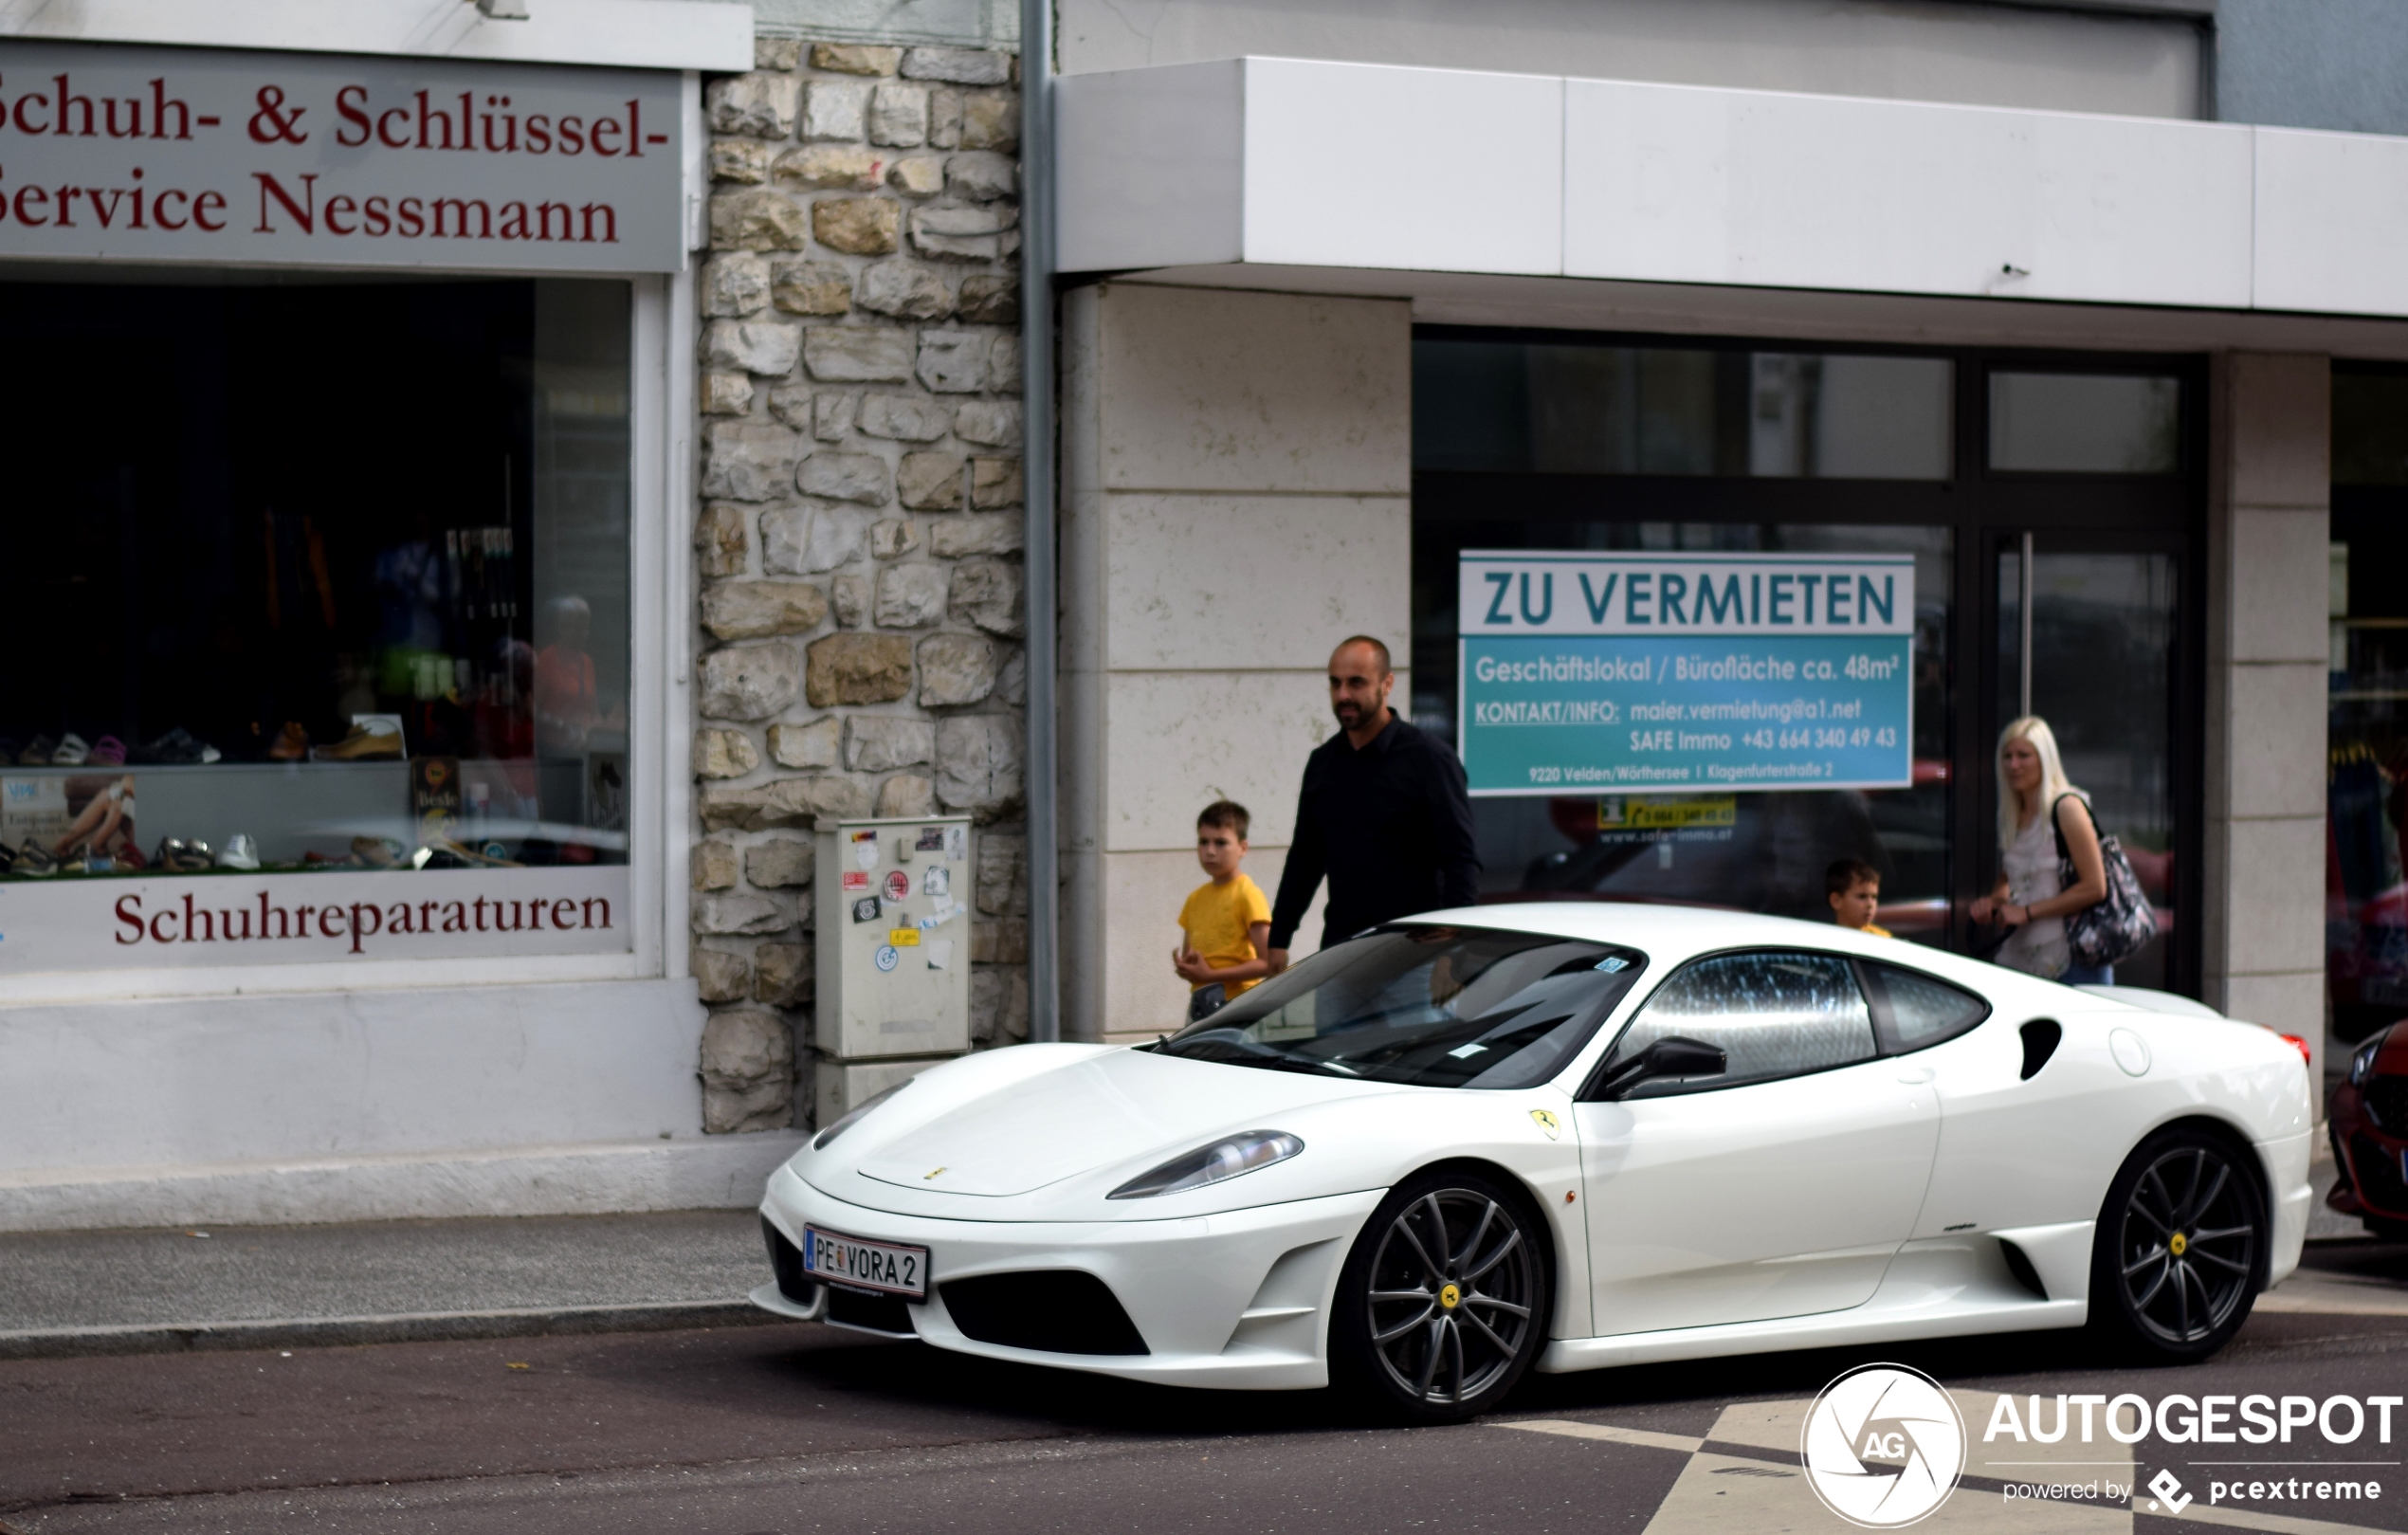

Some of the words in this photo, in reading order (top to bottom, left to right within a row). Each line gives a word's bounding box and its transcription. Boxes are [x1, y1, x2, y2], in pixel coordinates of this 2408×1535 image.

[0, 71, 221, 141] chuh-
[247, 84, 309, 146] &
[335, 85, 669, 158] Schlüssel-
[0, 163, 228, 233] ervice
[251, 172, 619, 244] Nessmann
[1484, 572, 1553, 626] ZU
[1578, 573, 1894, 626] VERMIETEN
[1475, 656, 1651, 683] Geschäftslokal
[1656, 657, 1669, 685] /
[1675, 654, 1796, 681] Bürofläche
[1802, 660, 1838, 681] ca.
[1844, 653, 1900, 681] 48m²
[1475, 701, 1620, 724] KONTAKT/INFO:
[1630, 698, 1862, 724] maier.vermietung@a1.net
[1630, 731, 1674, 752] SAFE
[1679, 731, 1732, 751] Immo
[1742, 729, 1774, 750] +43
[1779, 728, 1811, 749] 664
[1815, 727, 1846, 749] 340
[1850, 727, 1871, 747] 49
[1875, 726, 1896, 747] 43
[1529, 766, 1560, 782] 9220
[1564, 764, 1689, 782] Velden/Wörthersee
[1825, 762, 1833, 777] 2
[114, 891, 613, 954] Schuhreparaturen
[816, 1236, 834, 1271] PE
[847, 1245, 899, 1284] VORA
[903, 1253, 917, 1287] 2
